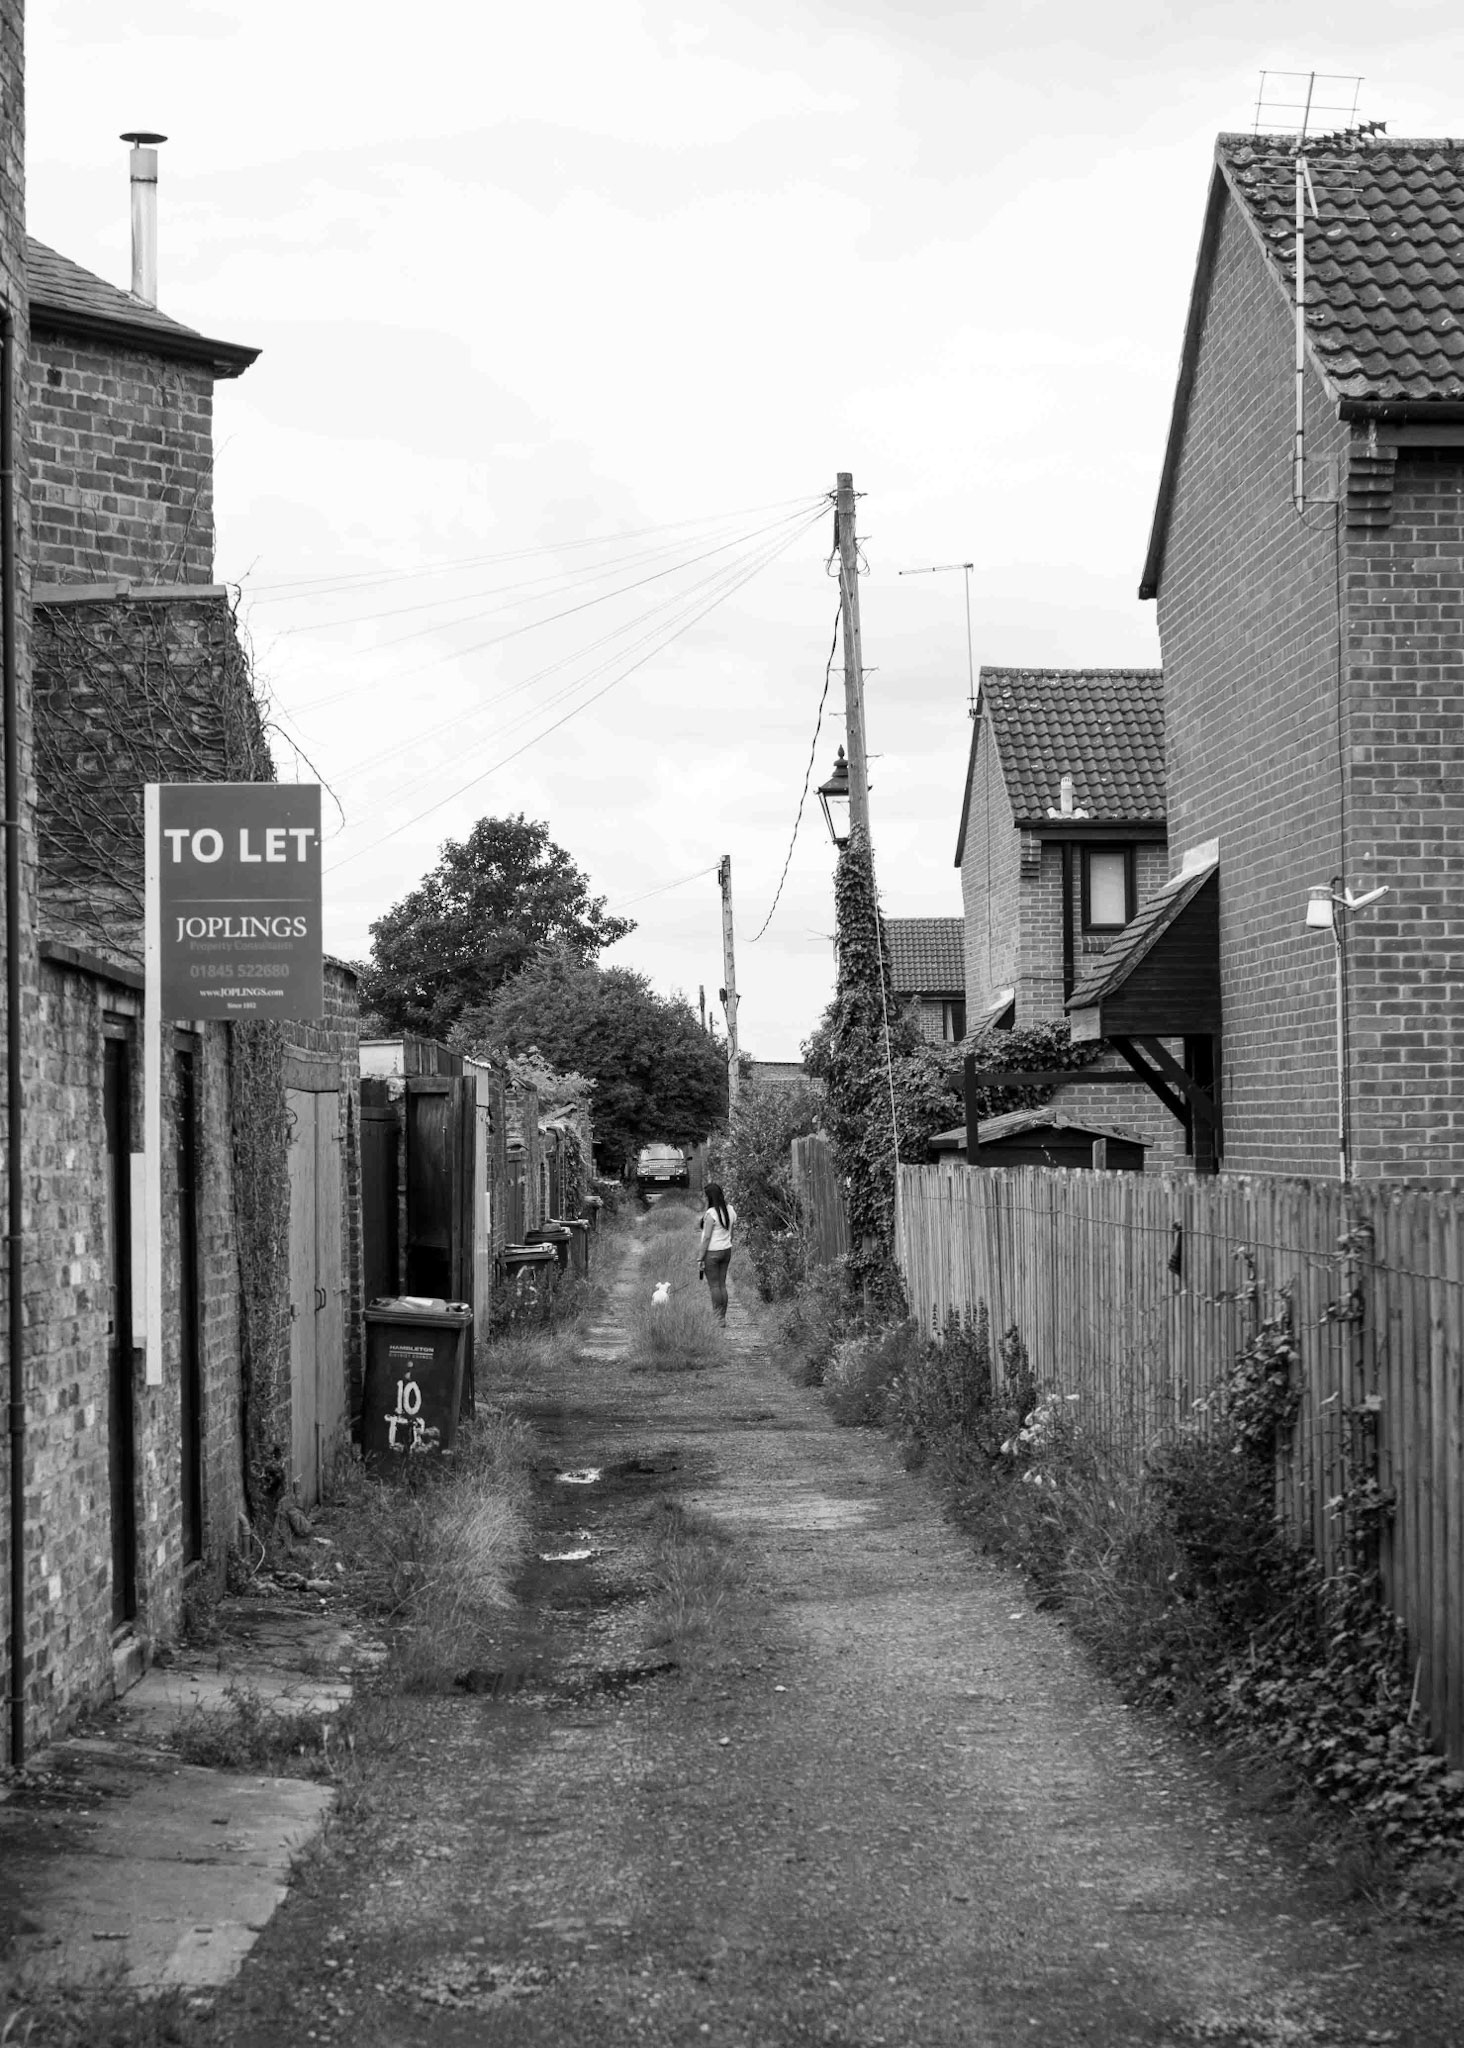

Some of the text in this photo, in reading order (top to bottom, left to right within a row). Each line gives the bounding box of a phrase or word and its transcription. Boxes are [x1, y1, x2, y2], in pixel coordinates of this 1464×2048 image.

[164, 828, 315, 863] TO LET
[176, 916, 307, 943] JOPLINGS
[190, 940, 232, 953] Property
[190, 963, 290, 978] 01845 522680
[199, 986, 284, 998] www.JOPLINGS.com
[394, 1380, 421, 1415] 10
